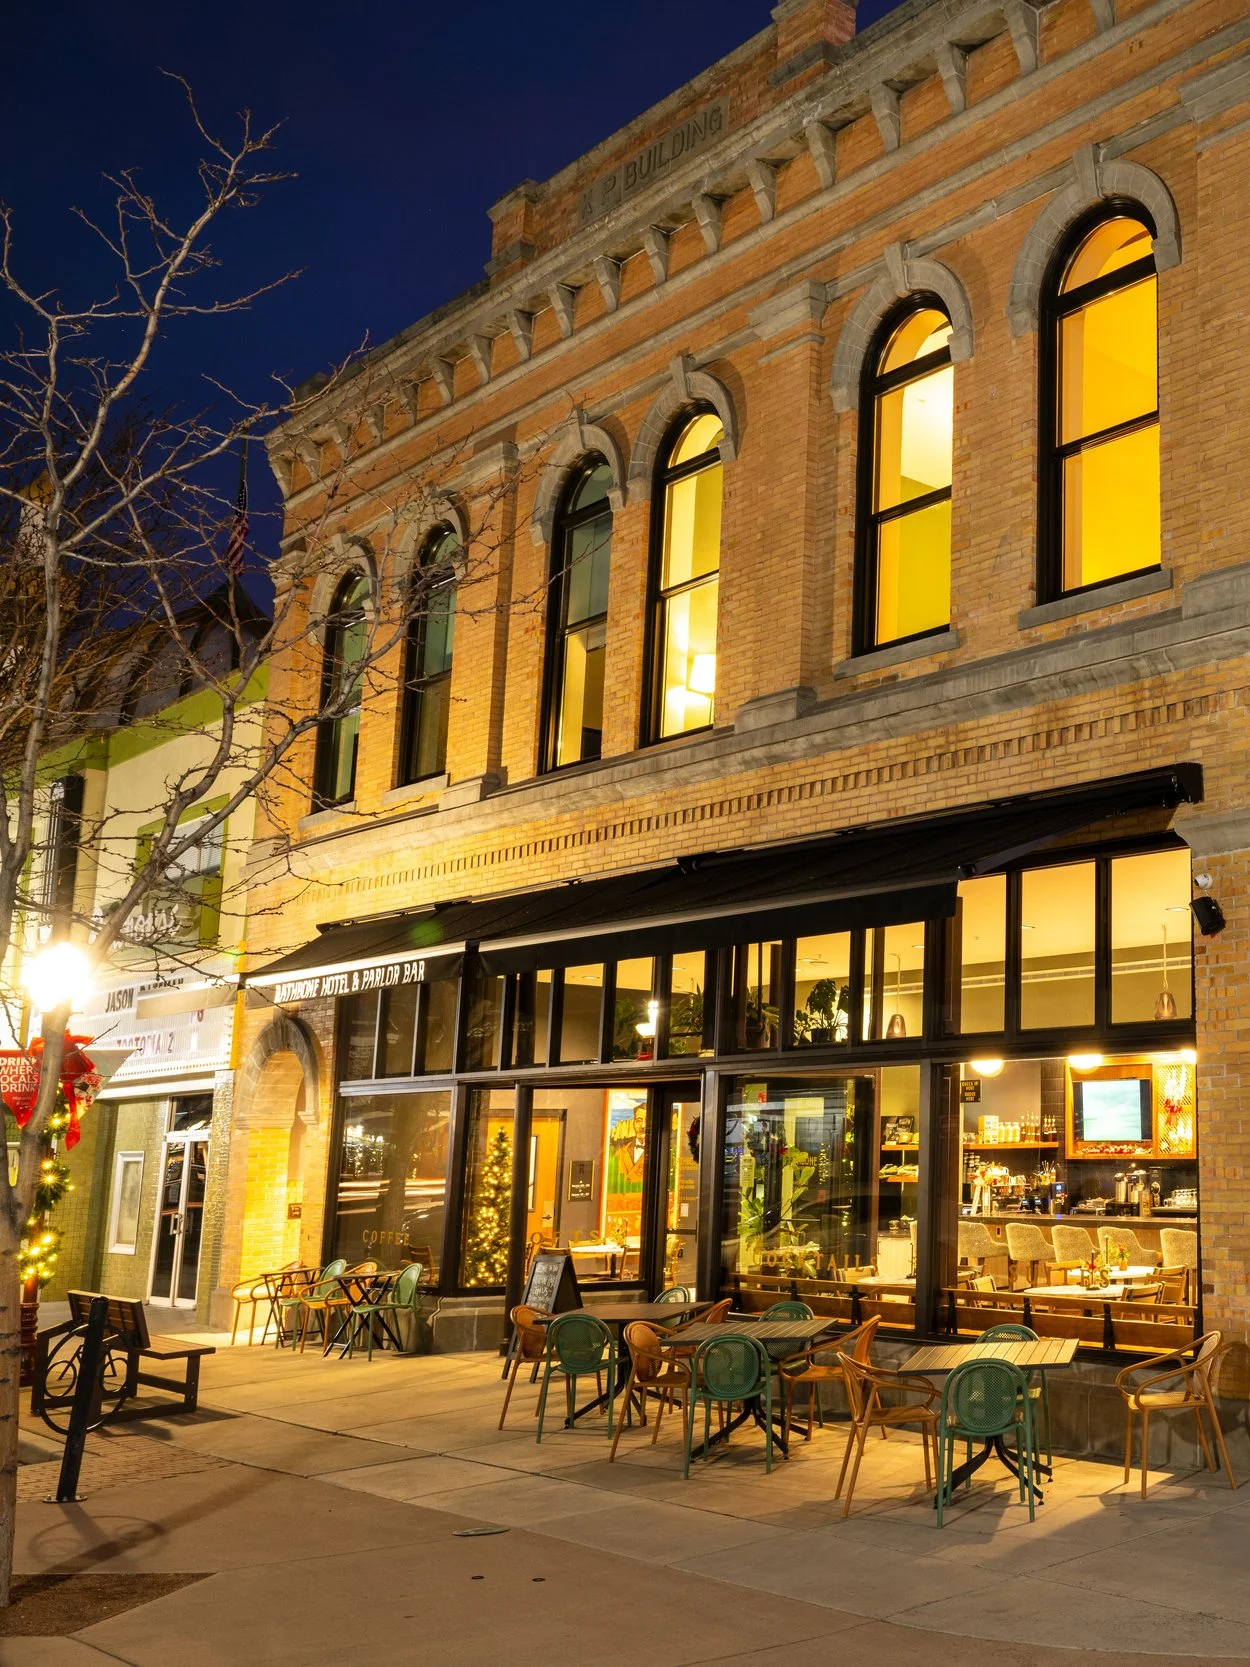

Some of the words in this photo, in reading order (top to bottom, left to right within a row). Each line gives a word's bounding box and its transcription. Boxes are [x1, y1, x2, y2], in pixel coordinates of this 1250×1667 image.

[625, 106, 722, 191] BUILDING
[274, 978, 319, 1003] RATHBONE
[320, 973, 350, 997] HOTEL
[352, 971, 359, 992] &
[361, 965, 400, 990] PARLOR
[402, 960, 425, 983] BAR
[105, 988, 134, 1013] JASON
[168, 1031, 174, 1054] 2
[0, 1074, 39, 1084] OCALS
[362, 1229, 409, 1246] COFFEE
